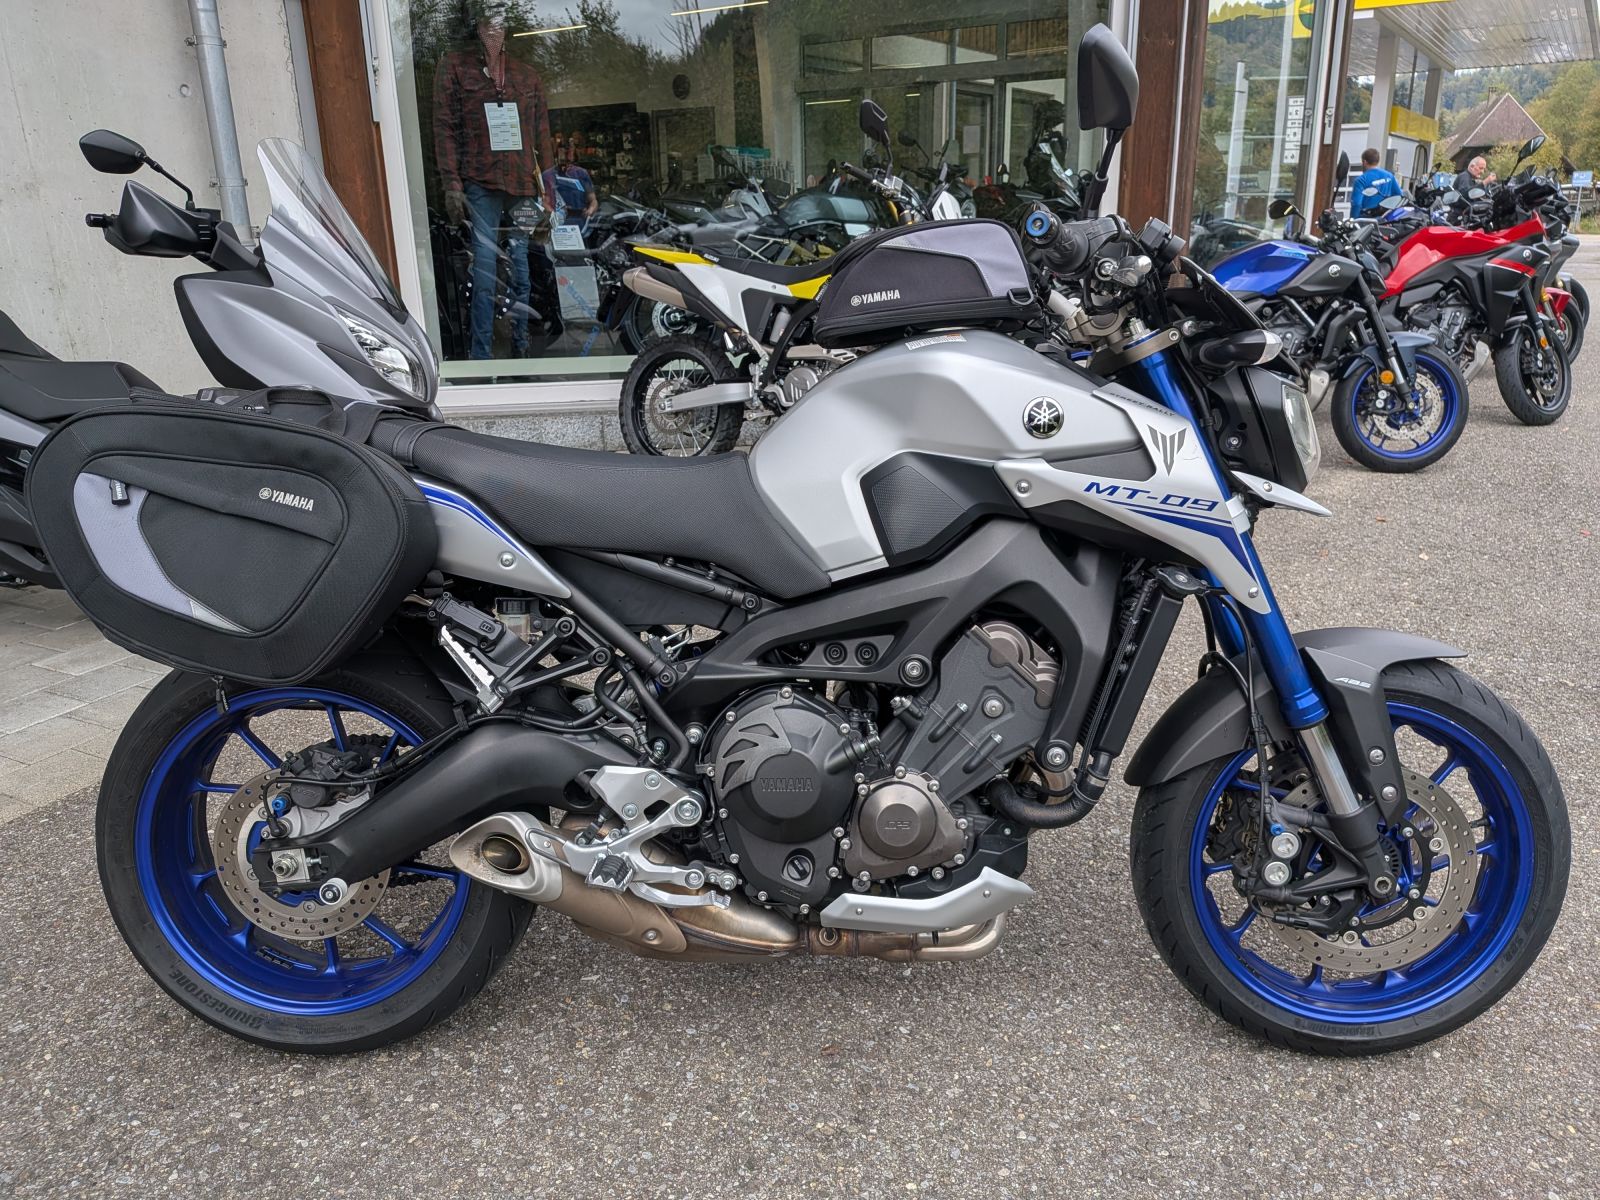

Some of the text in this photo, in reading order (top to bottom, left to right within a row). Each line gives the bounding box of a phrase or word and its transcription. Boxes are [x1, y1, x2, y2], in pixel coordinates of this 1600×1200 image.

[862, 289, 901, 304] YAMAHA
[1147, 404, 1176, 417] RALLY
[271, 490, 315, 512] YAMAHA
[1083, 481, 1219, 512] MT-09
[1333, 677, 1373, 689] ABS
[759, 776, 814, 792] YAMAHA
[168, 969, 264, 1030] BRIDGESTONE
